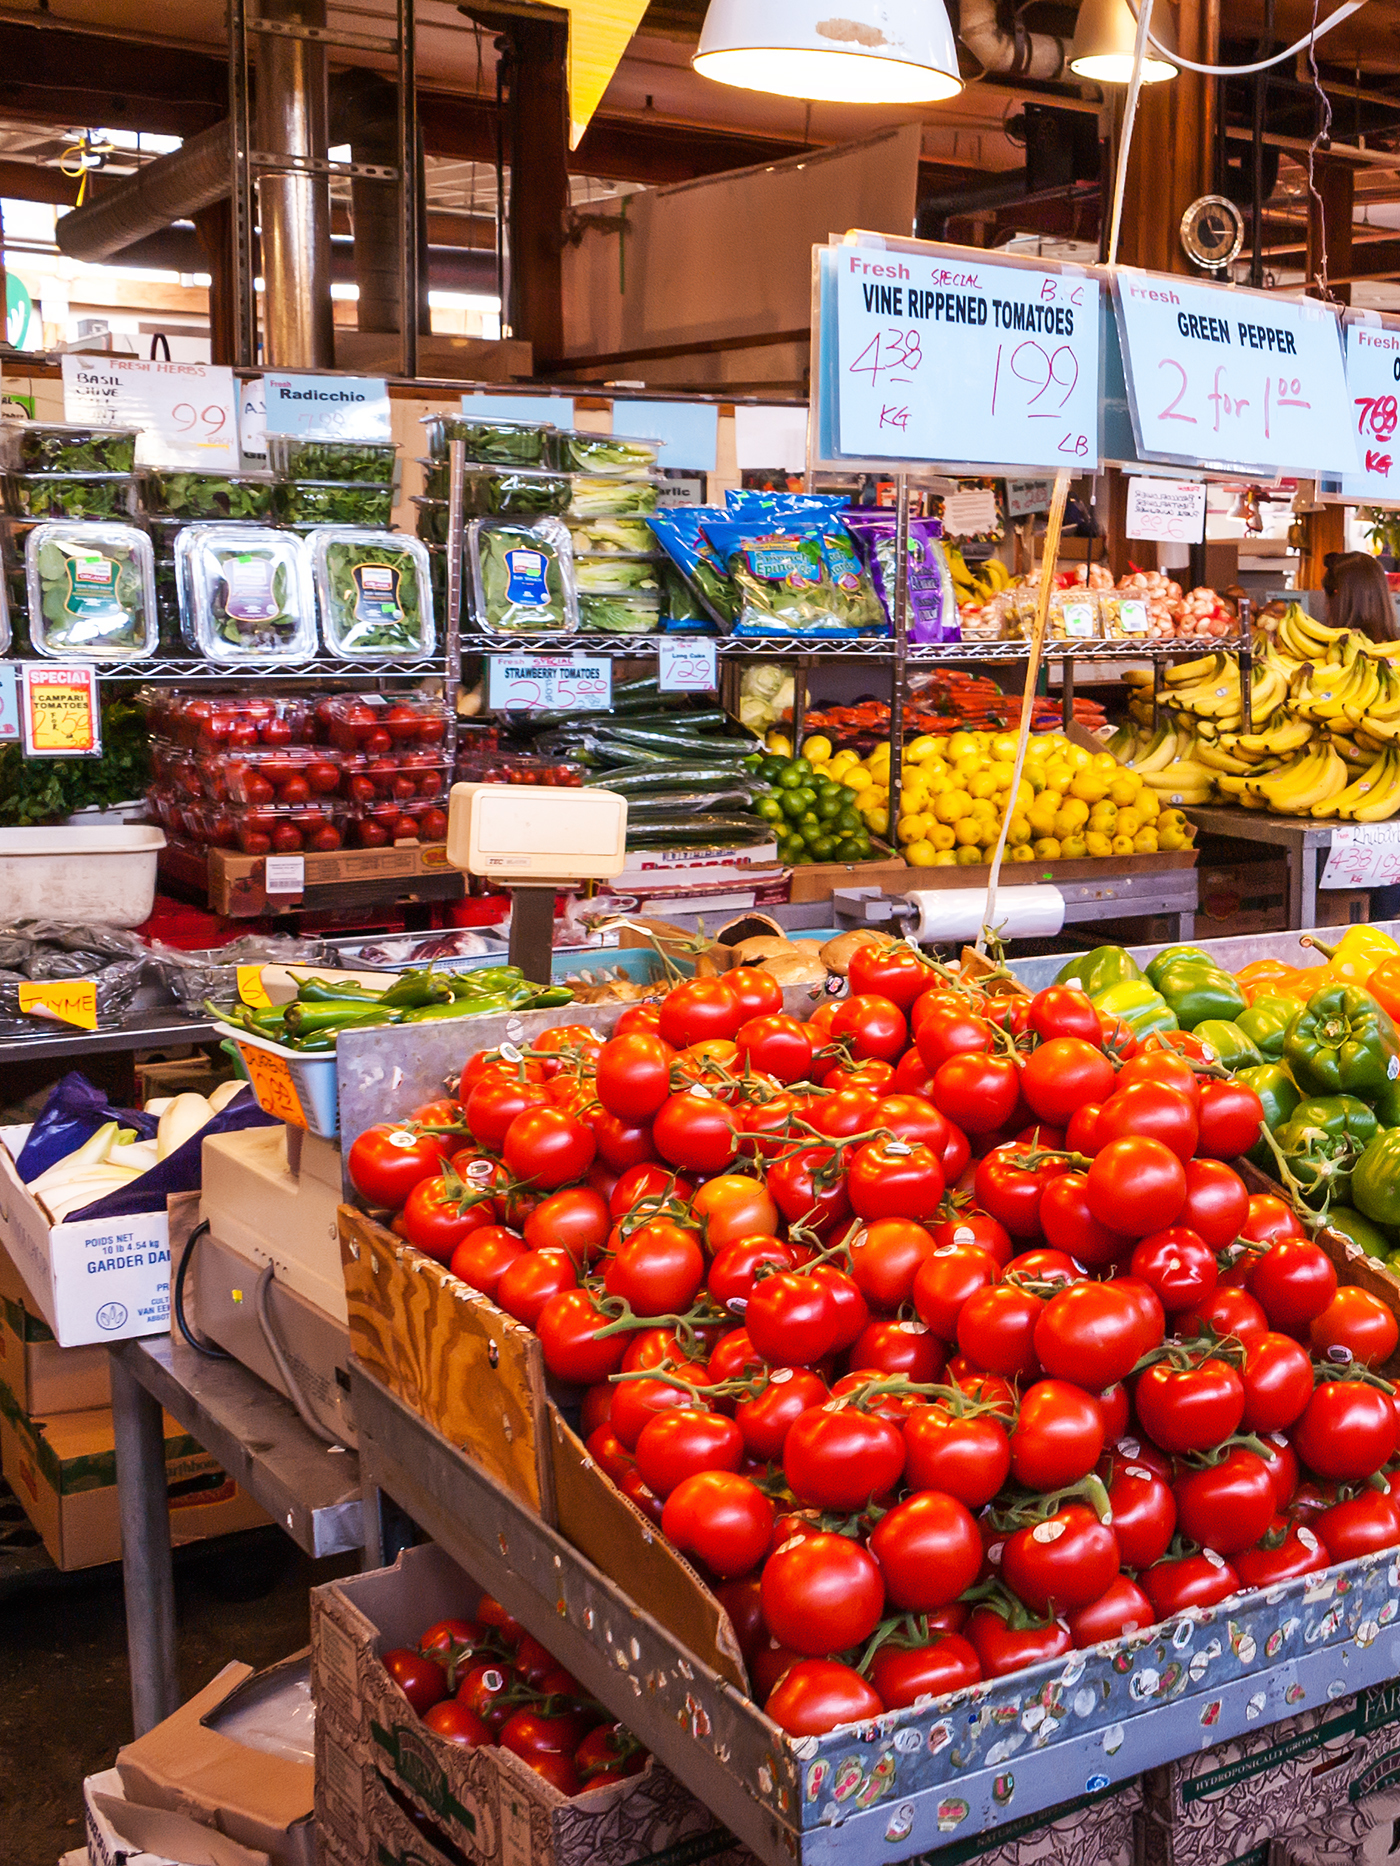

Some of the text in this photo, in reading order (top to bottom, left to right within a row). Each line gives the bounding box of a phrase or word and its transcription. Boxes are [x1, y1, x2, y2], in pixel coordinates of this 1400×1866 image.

[850, 257, 911, 280] Fresh
[931, 268, 983, 289] SPECIAL
[1130, 285, 1181, 306] Fresh
[863, 283, 1075, 336] VINE RIPPENED TOMATOES
[1177, 311, 1298, 355] GREEN PEPPER
[1358, 331, 1400, 350] Fresh
[76, 372, 124, 386] BASIL
[109, 360, 206, 377] FRESH HERBS
[280, 388, 366, 402] Radicchio
[1158, 358, 1197, 424] 2
[1207, 365, 1250, 432] for
[879, 404, 913, 432] KG
[1058, 433, 1089, 456] LB
[1366, 449, 1393, 477] KG
[656, 486, 691, 497] arlic
[498, 658, 525, 666] Fresh
[30, 671, 90, 684] SPECIAL
[505, 668, 600, 679] STRAWBERRY TOMATOES
[505, 680, 549, 710] 2
[29, 710, 50, 736] 2
[85, 1233, 134, 1248] POIDS NET
[102, 1240, 160, 1255] 10 lb 4.54 kg
[87, 1250, 171, 1274] GARDER DA
[137, 1306, 155, 1316] VAN
[1195, 1732, 1321, 1791] HYDROPONICALLY GROWN
